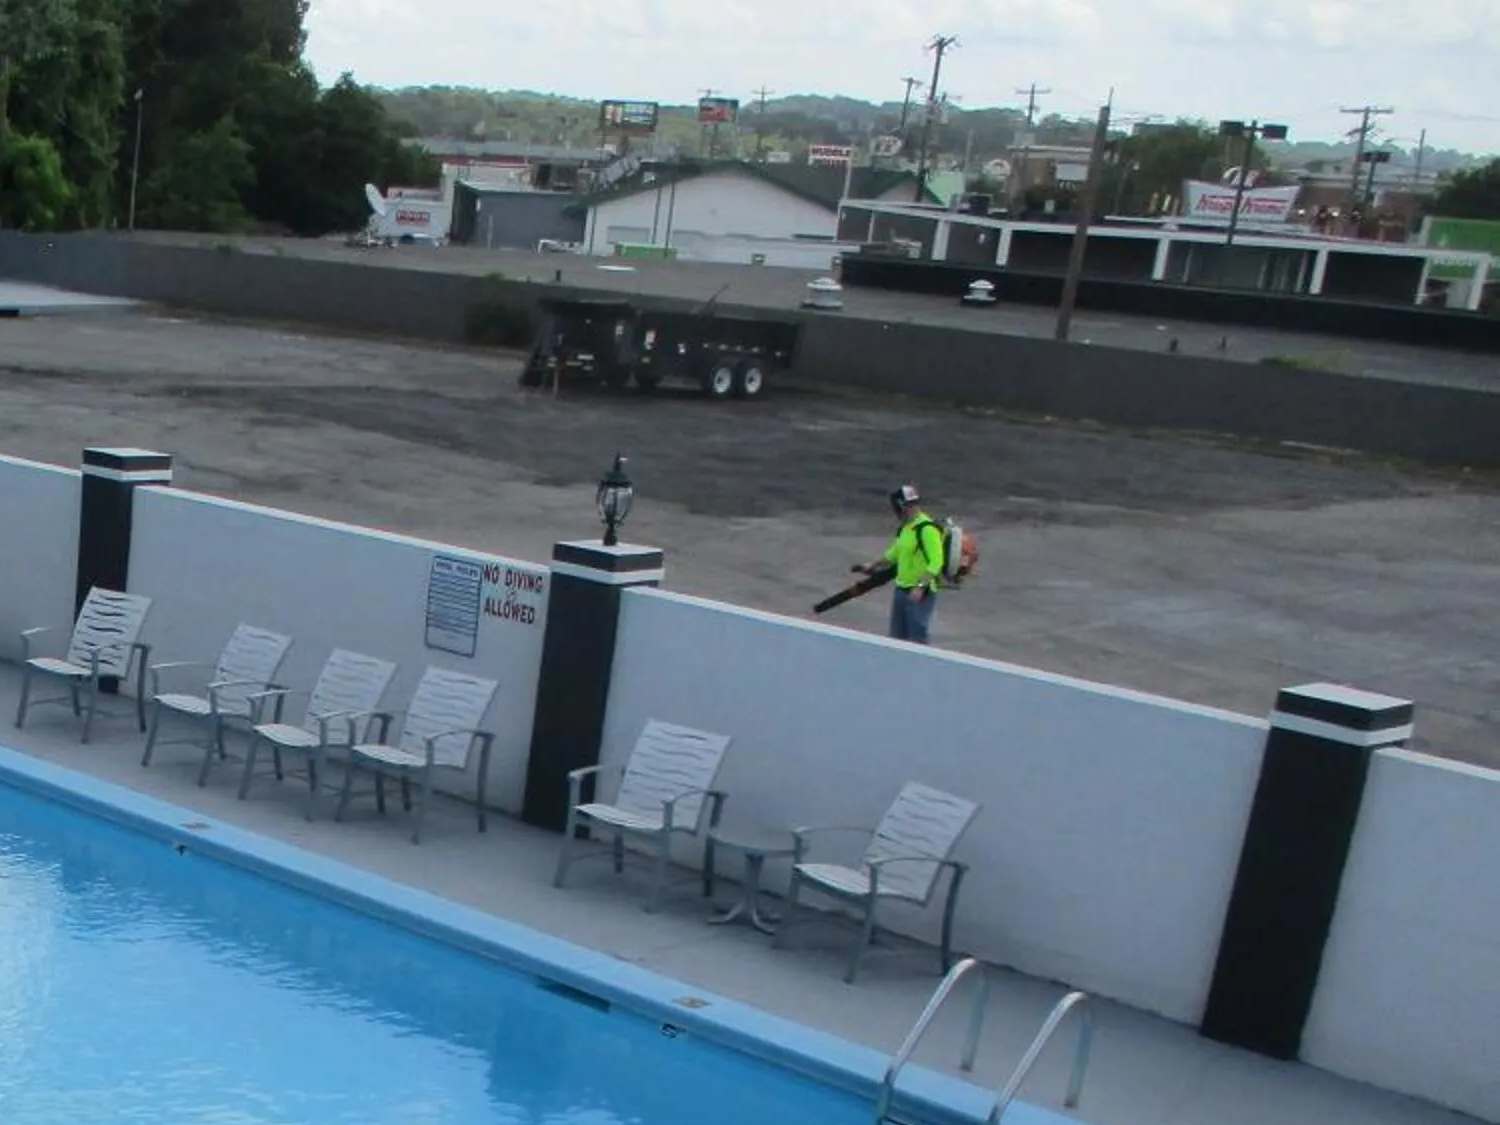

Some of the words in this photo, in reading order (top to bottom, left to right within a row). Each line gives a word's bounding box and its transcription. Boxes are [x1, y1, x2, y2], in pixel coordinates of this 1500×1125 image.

[484, 563, 500, 585] NO
[505, 568, 543, 593] DIVING
[484, 596, 536, 625] ALLOWED
